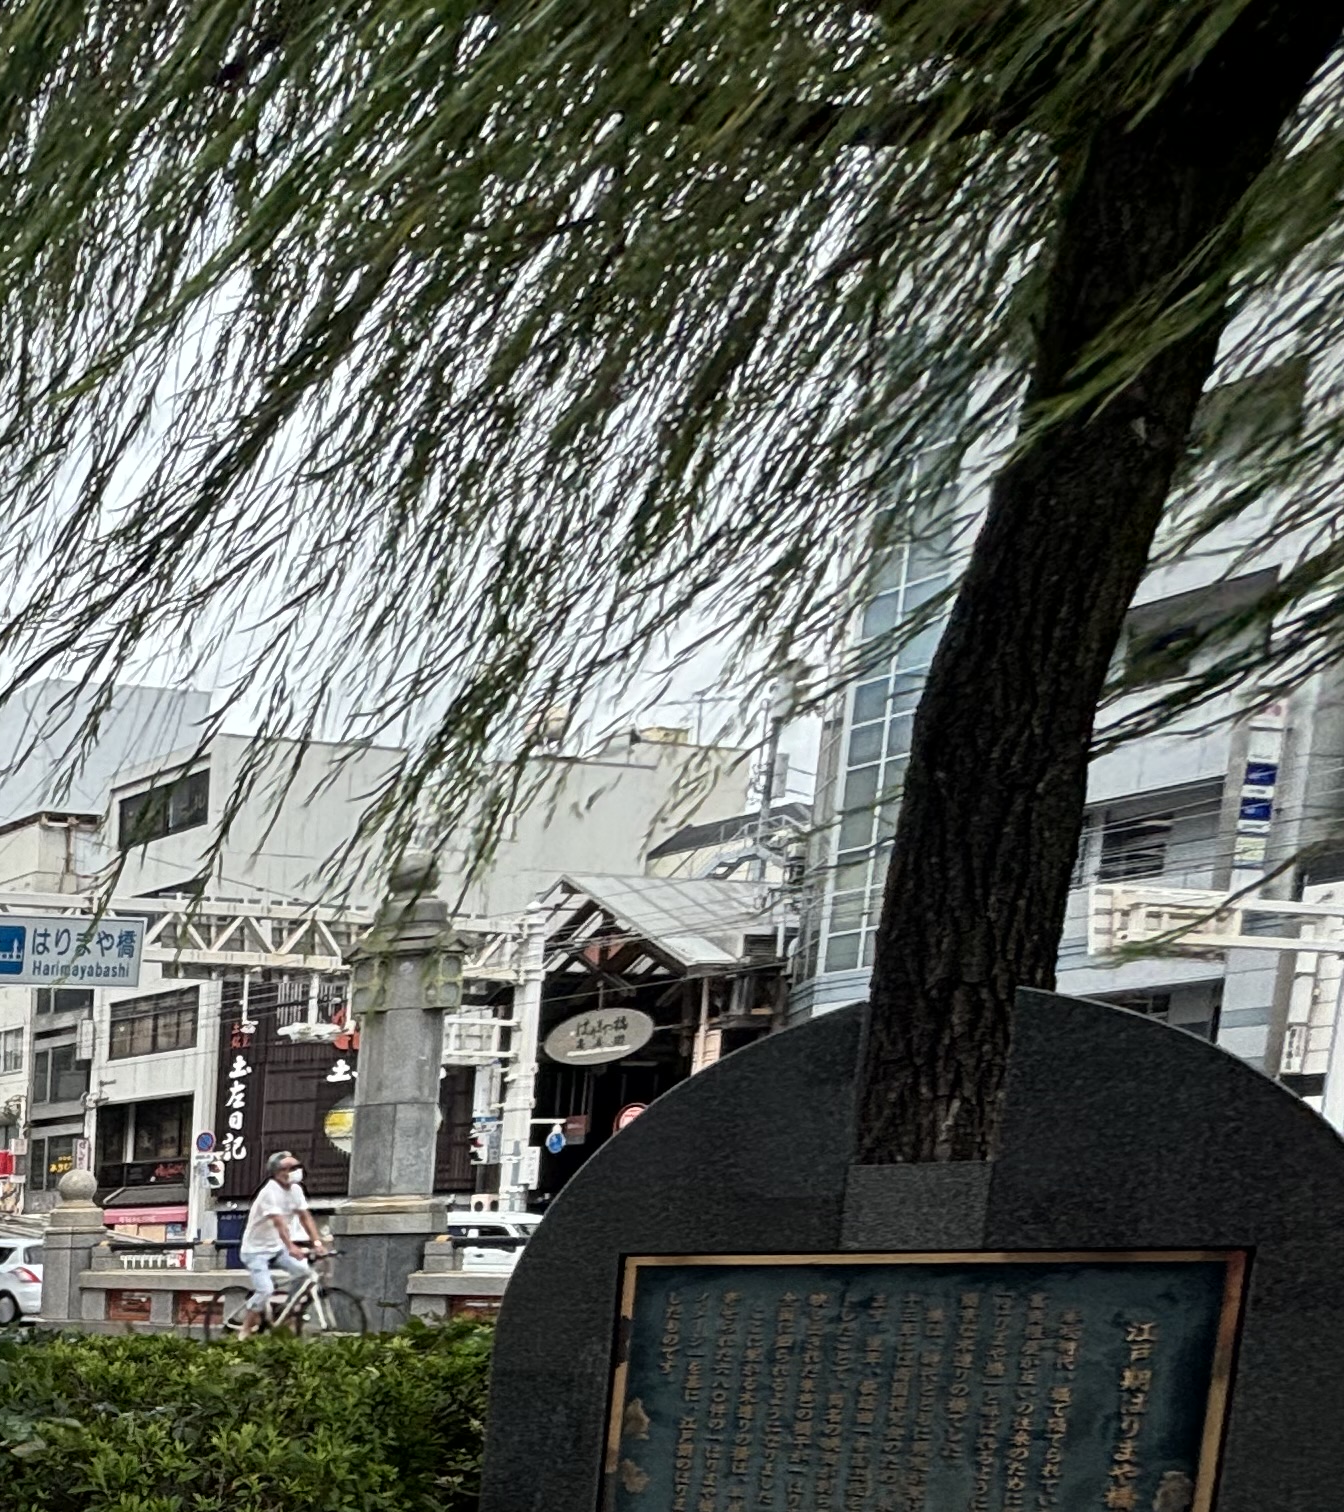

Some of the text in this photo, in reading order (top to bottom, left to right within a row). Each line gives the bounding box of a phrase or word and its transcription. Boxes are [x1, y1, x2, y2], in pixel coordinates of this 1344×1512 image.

[31, 928, 137, 959] はりまや橋
[32, 960, 129, 980] Harimayabashi
